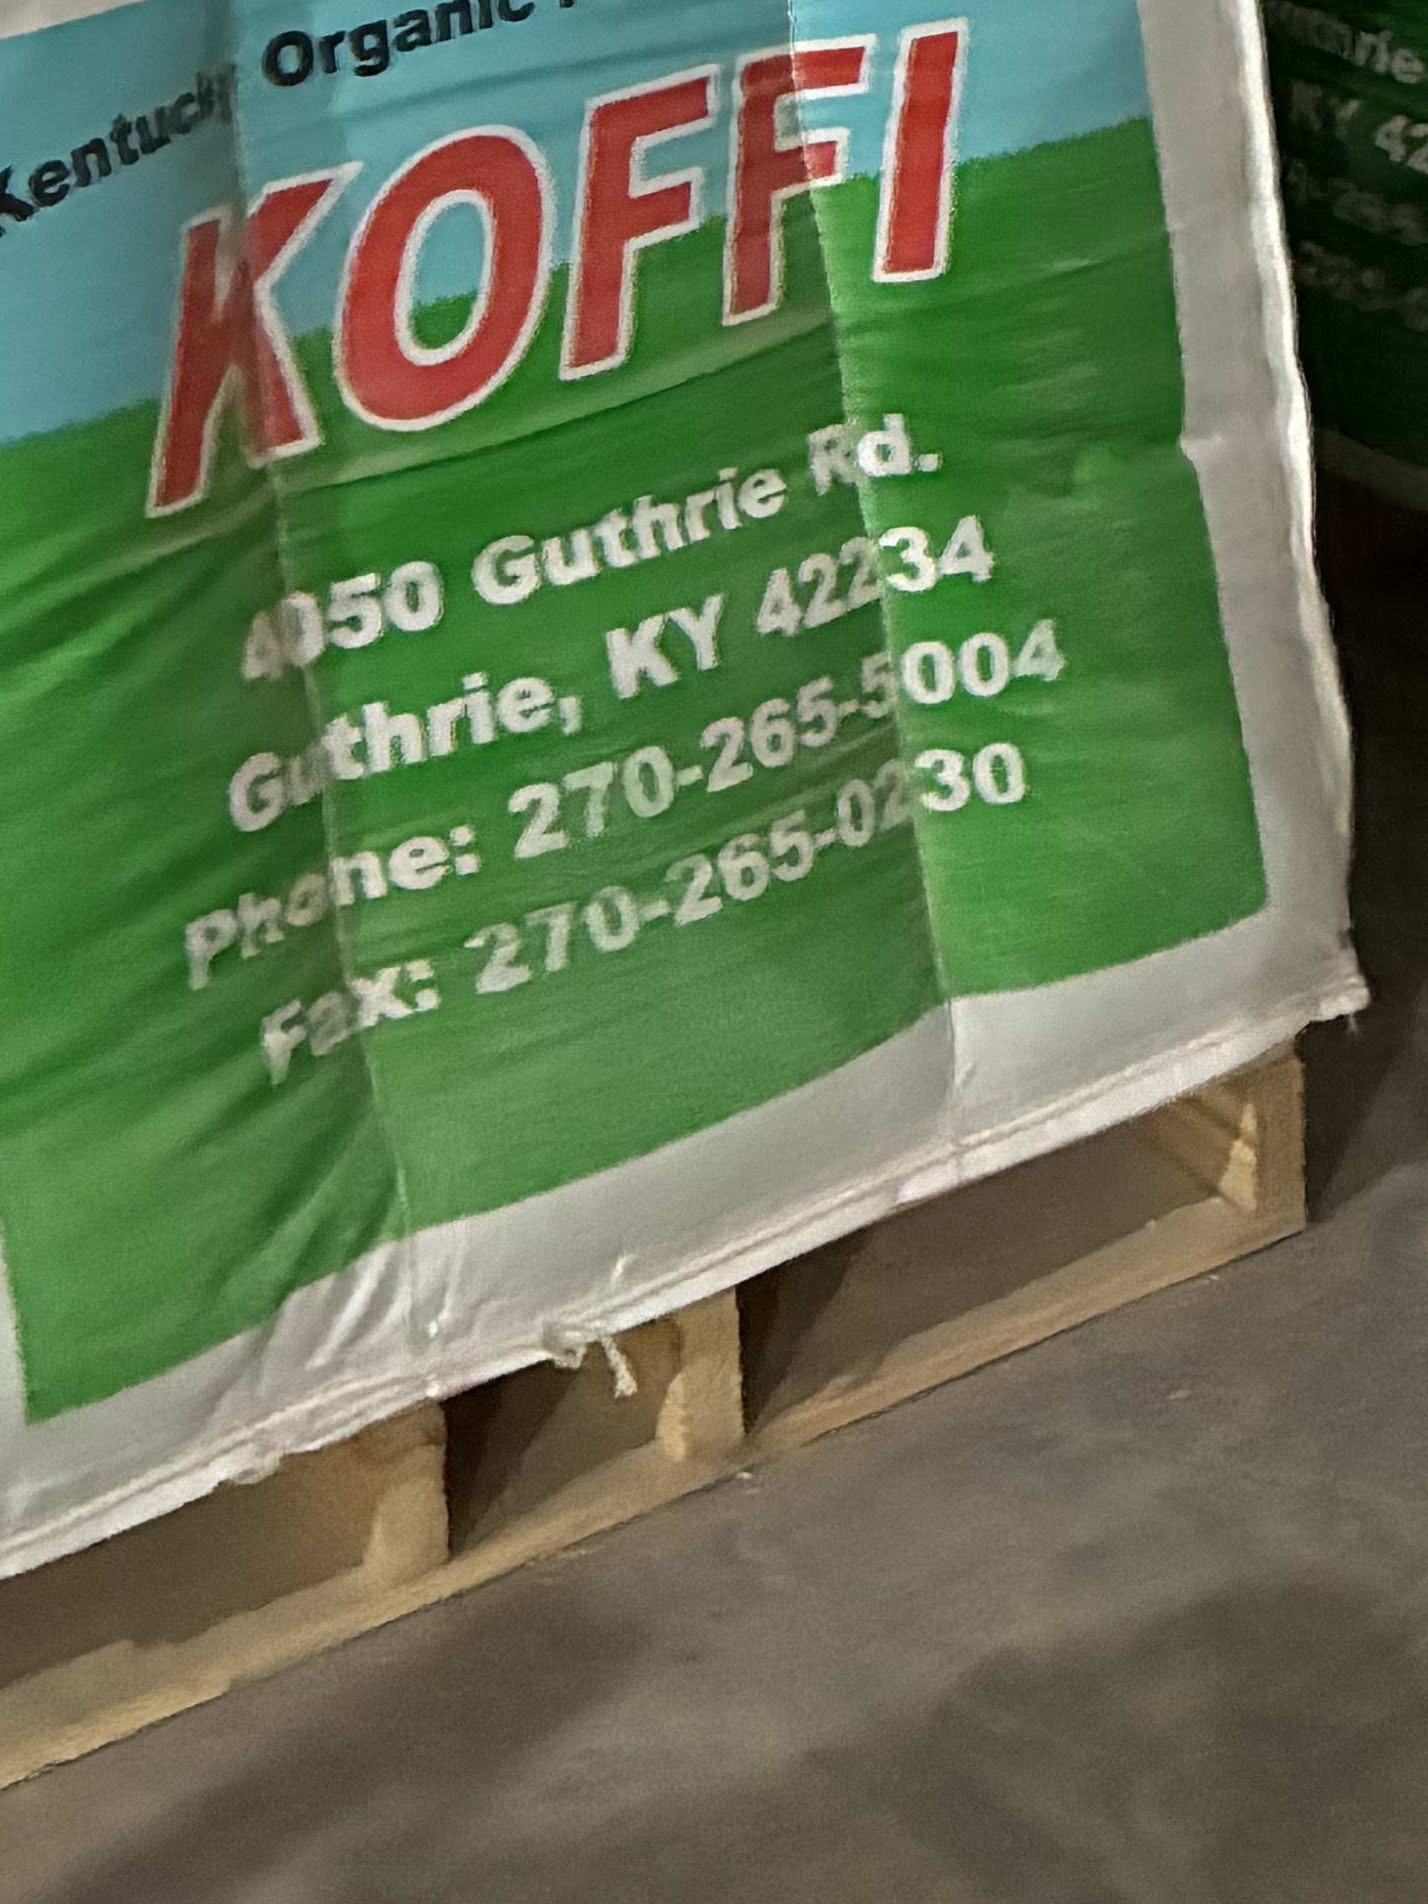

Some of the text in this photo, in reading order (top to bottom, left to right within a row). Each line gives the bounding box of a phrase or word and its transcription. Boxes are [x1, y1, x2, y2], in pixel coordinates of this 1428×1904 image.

[145, 15, 971, 518] KOFFI
[228, 514, 995, 832] Guthrie, KY 42234
[242, 412, 942, 681] 4050 Guthrie Rd.
[184, 618, 1067, 991] Phone: 270-265-5004
[259, 741, 1028, 1085] Fax: 270-265-0230
